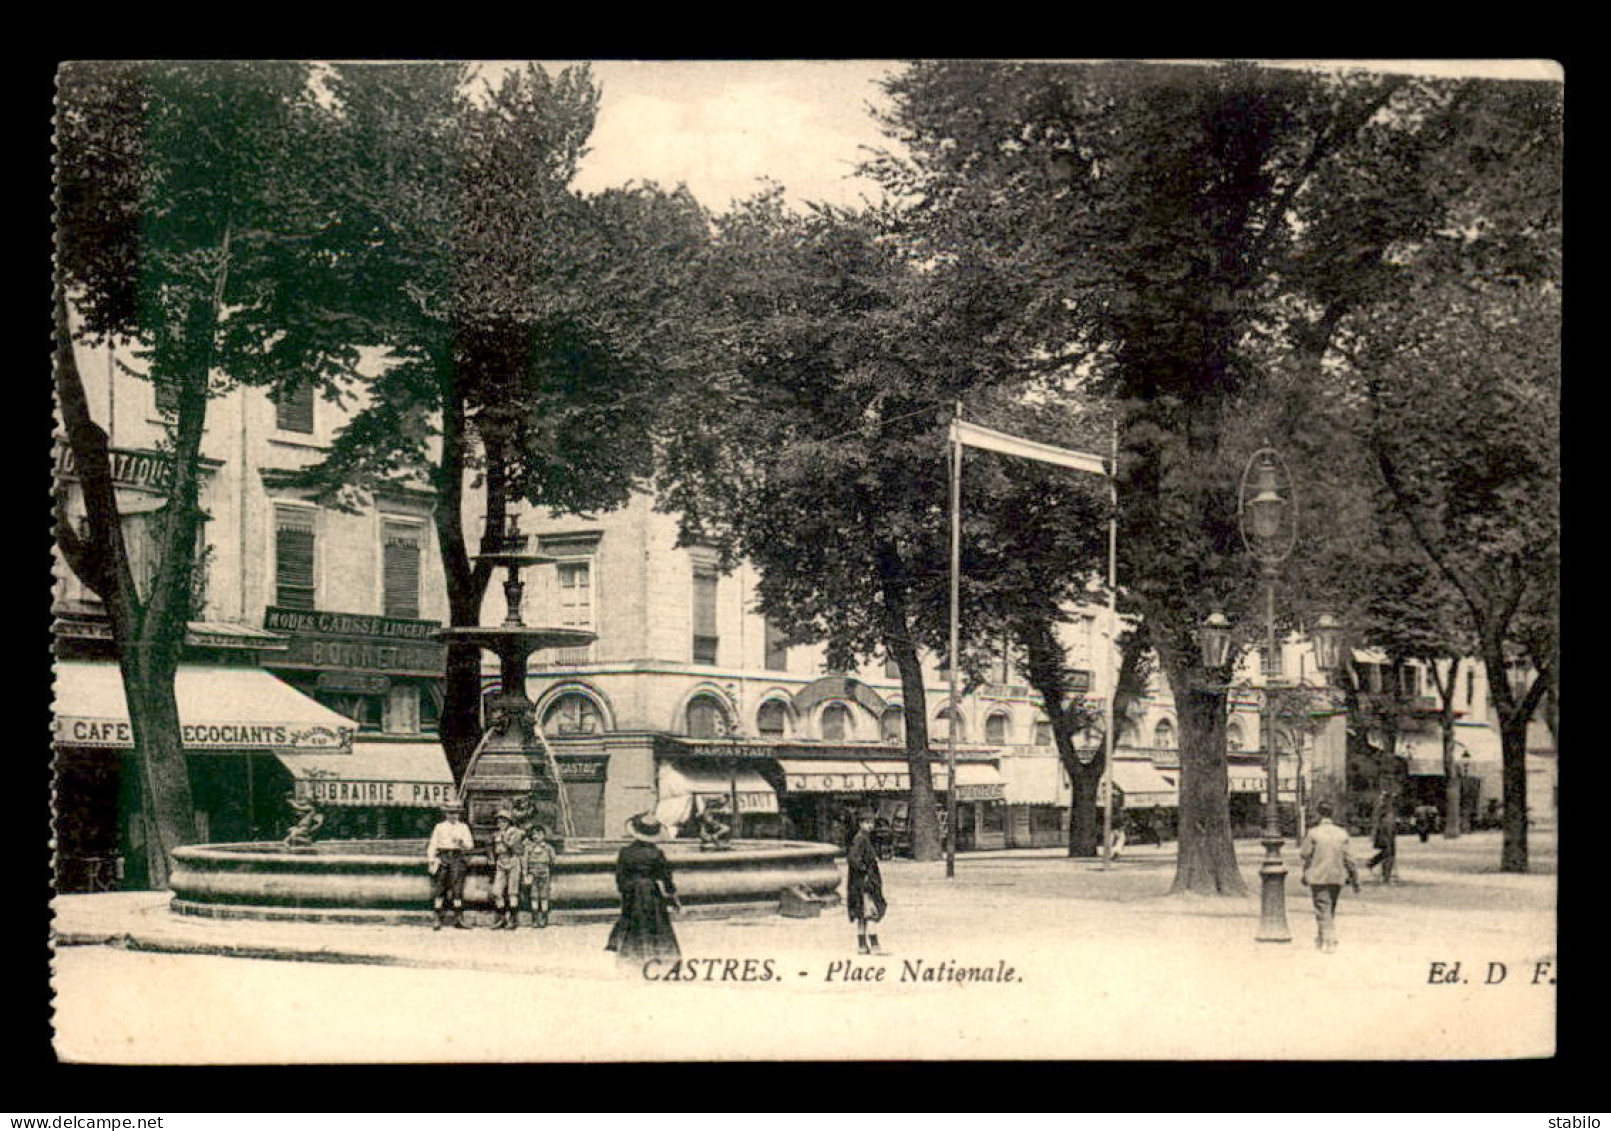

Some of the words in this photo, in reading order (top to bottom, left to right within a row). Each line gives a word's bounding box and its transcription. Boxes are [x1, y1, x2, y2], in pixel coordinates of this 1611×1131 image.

[73, 721, 130, 742] CAFE
[183, 723, 286, 744] EGOCIANTS
[823, 774, 902, 789] OLIVI
[314, 783, 394, 801] LIBRAIRIE
[413, 785, 452, 802] PAPE
